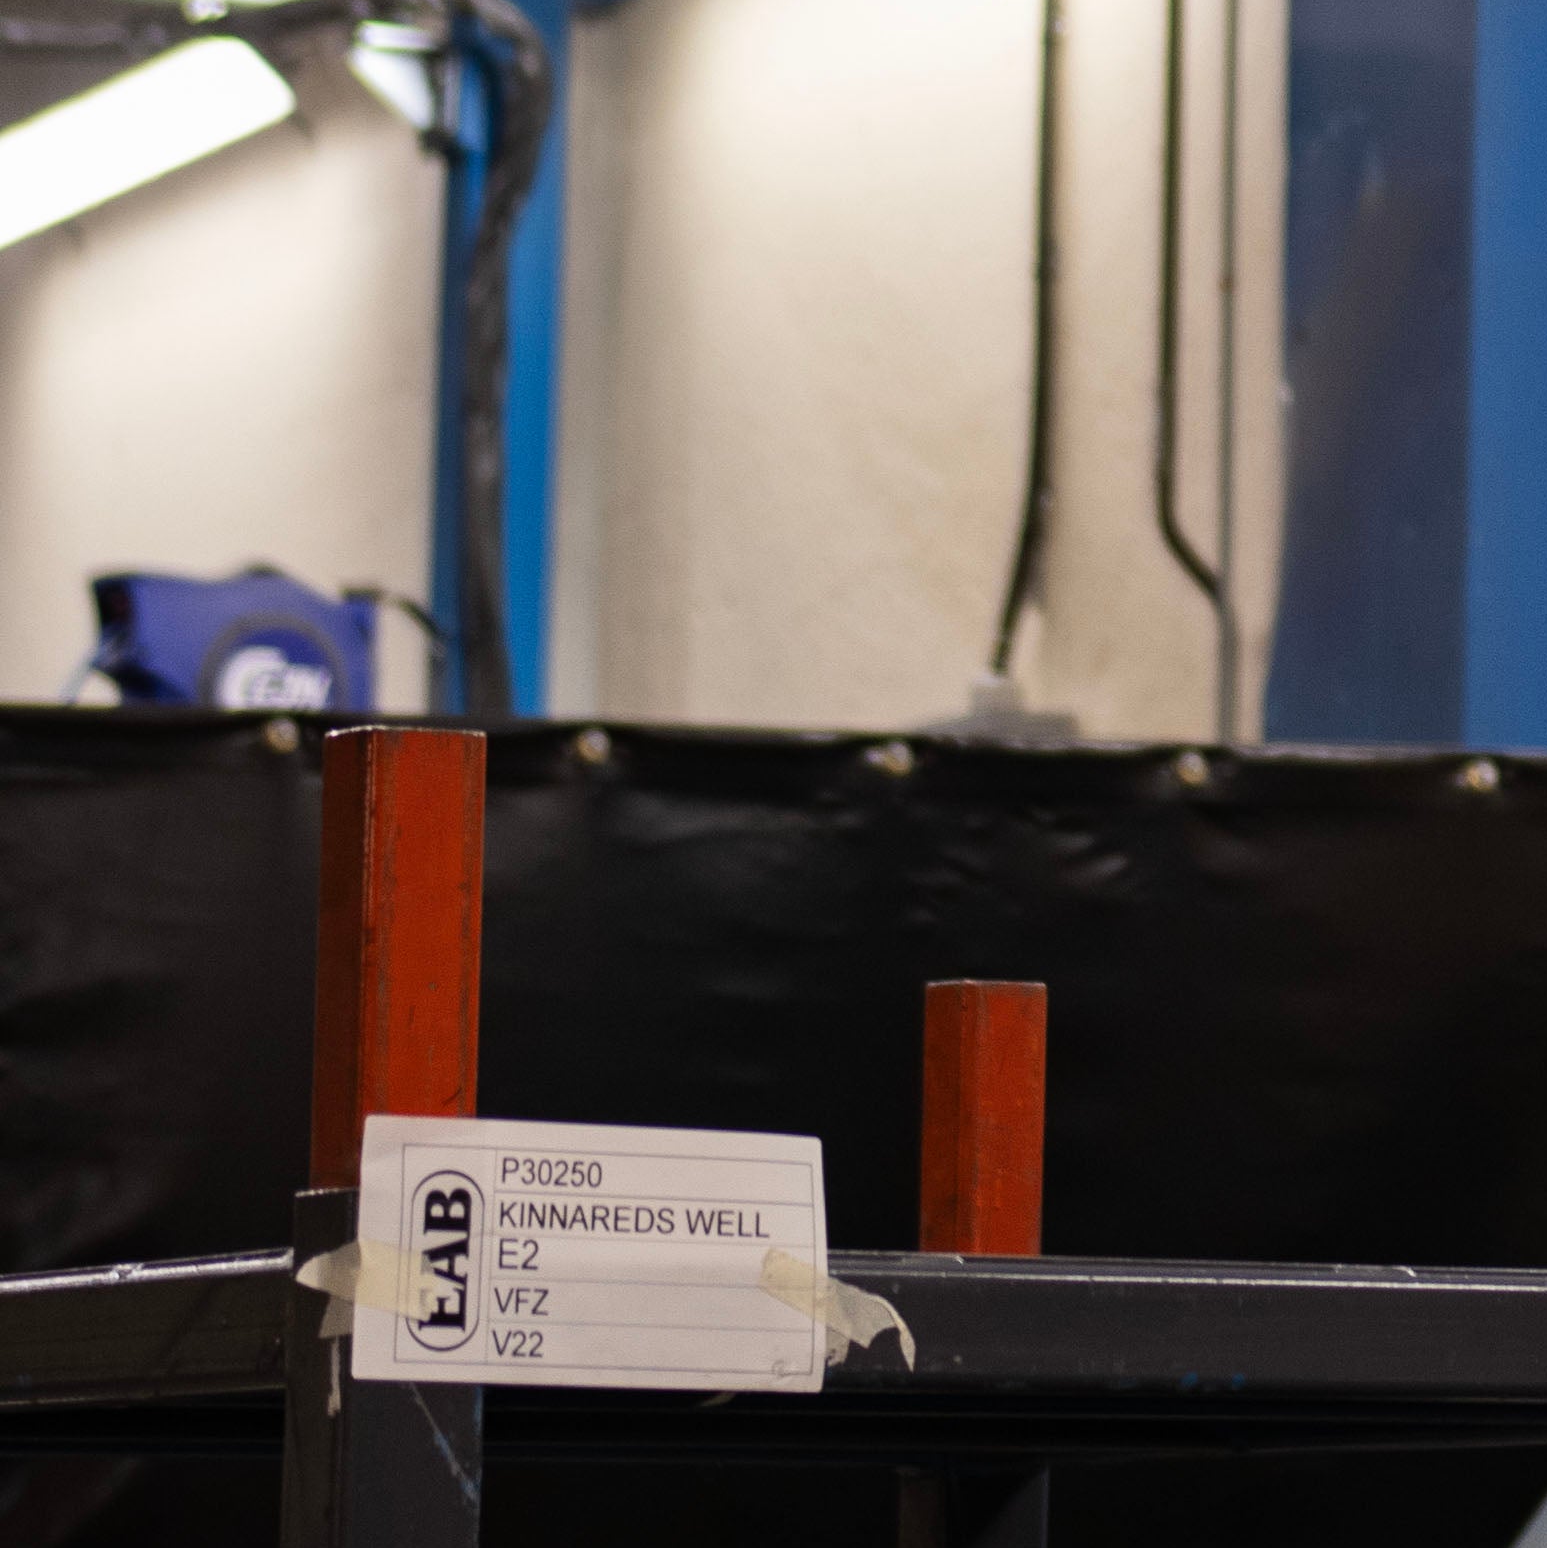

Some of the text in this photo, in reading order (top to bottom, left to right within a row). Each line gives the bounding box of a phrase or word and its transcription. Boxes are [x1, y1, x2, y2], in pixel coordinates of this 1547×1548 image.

[501, 1156, 604, 1190] P30250
[499, 1200, 771, 1239] KINNAREDS WELL
[417, 1187, 473, 1332] EAB
[499, 1238, 541, 1272] E2
[493, 1287, 550, 1317] VFZ
[491, 1330, 545, 1359] V22
